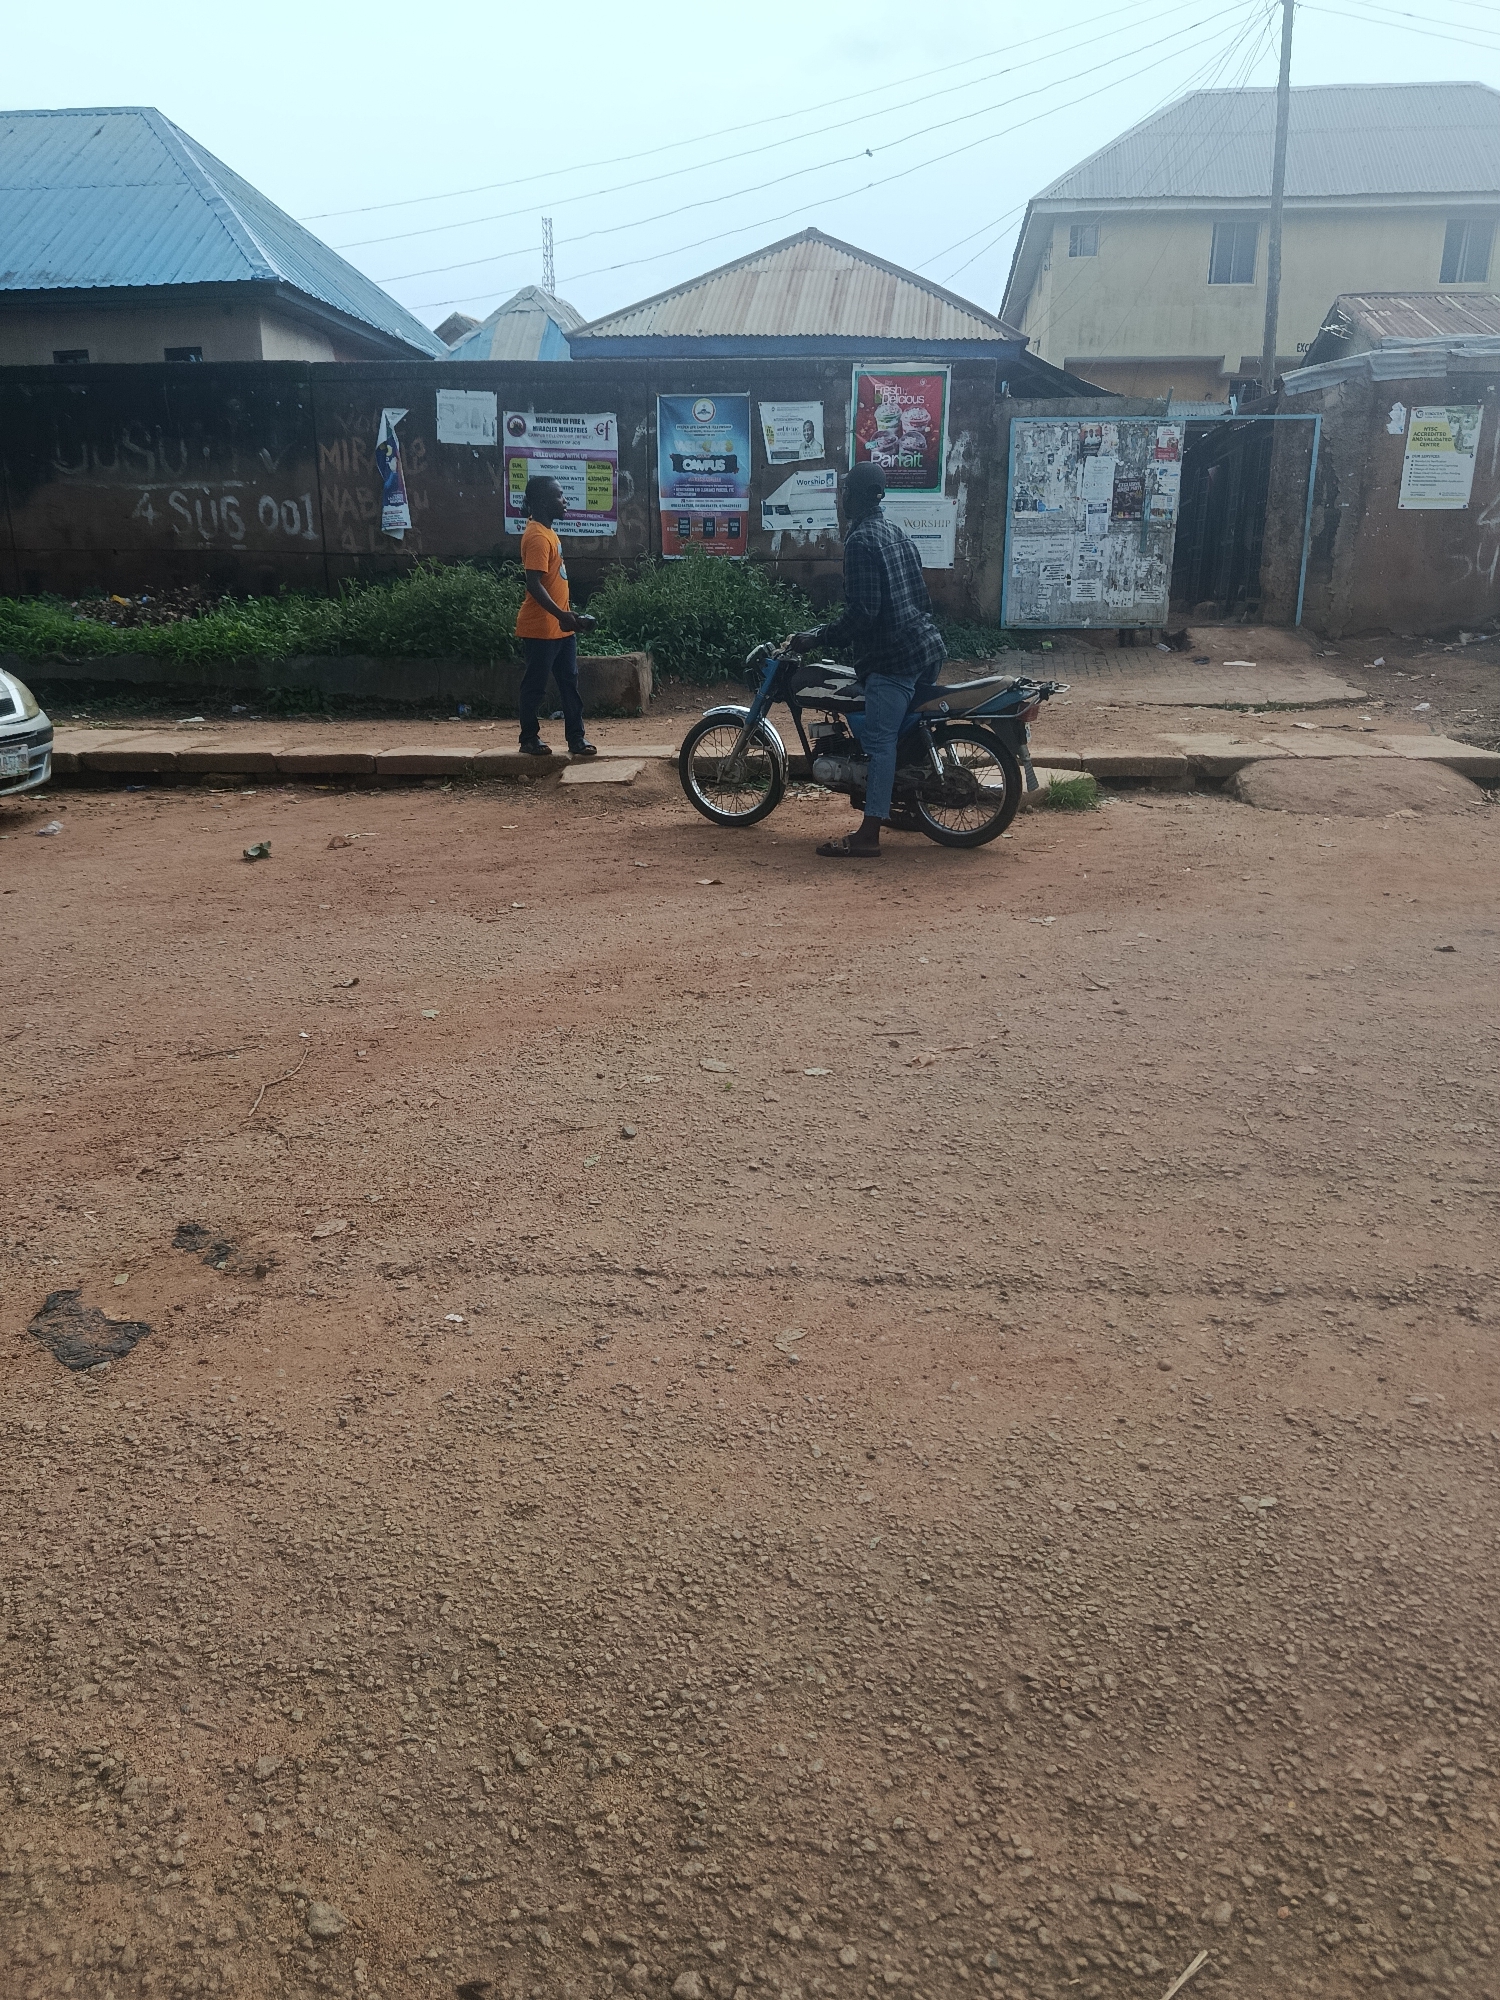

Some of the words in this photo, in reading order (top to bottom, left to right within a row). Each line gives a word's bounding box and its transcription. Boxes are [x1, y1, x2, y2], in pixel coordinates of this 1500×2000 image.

[1296, 342, 1313, 353] EXC
[874, 384, 902, 395] Fresh
[881, 392, 925, 405] Delicious
[682, 458, 726, 472] CAMPUS
[870, 450, 924, 469] Parfait
[796, 475, 826, 487] Worship
[903, 516, 951, 530] WORSHIP
